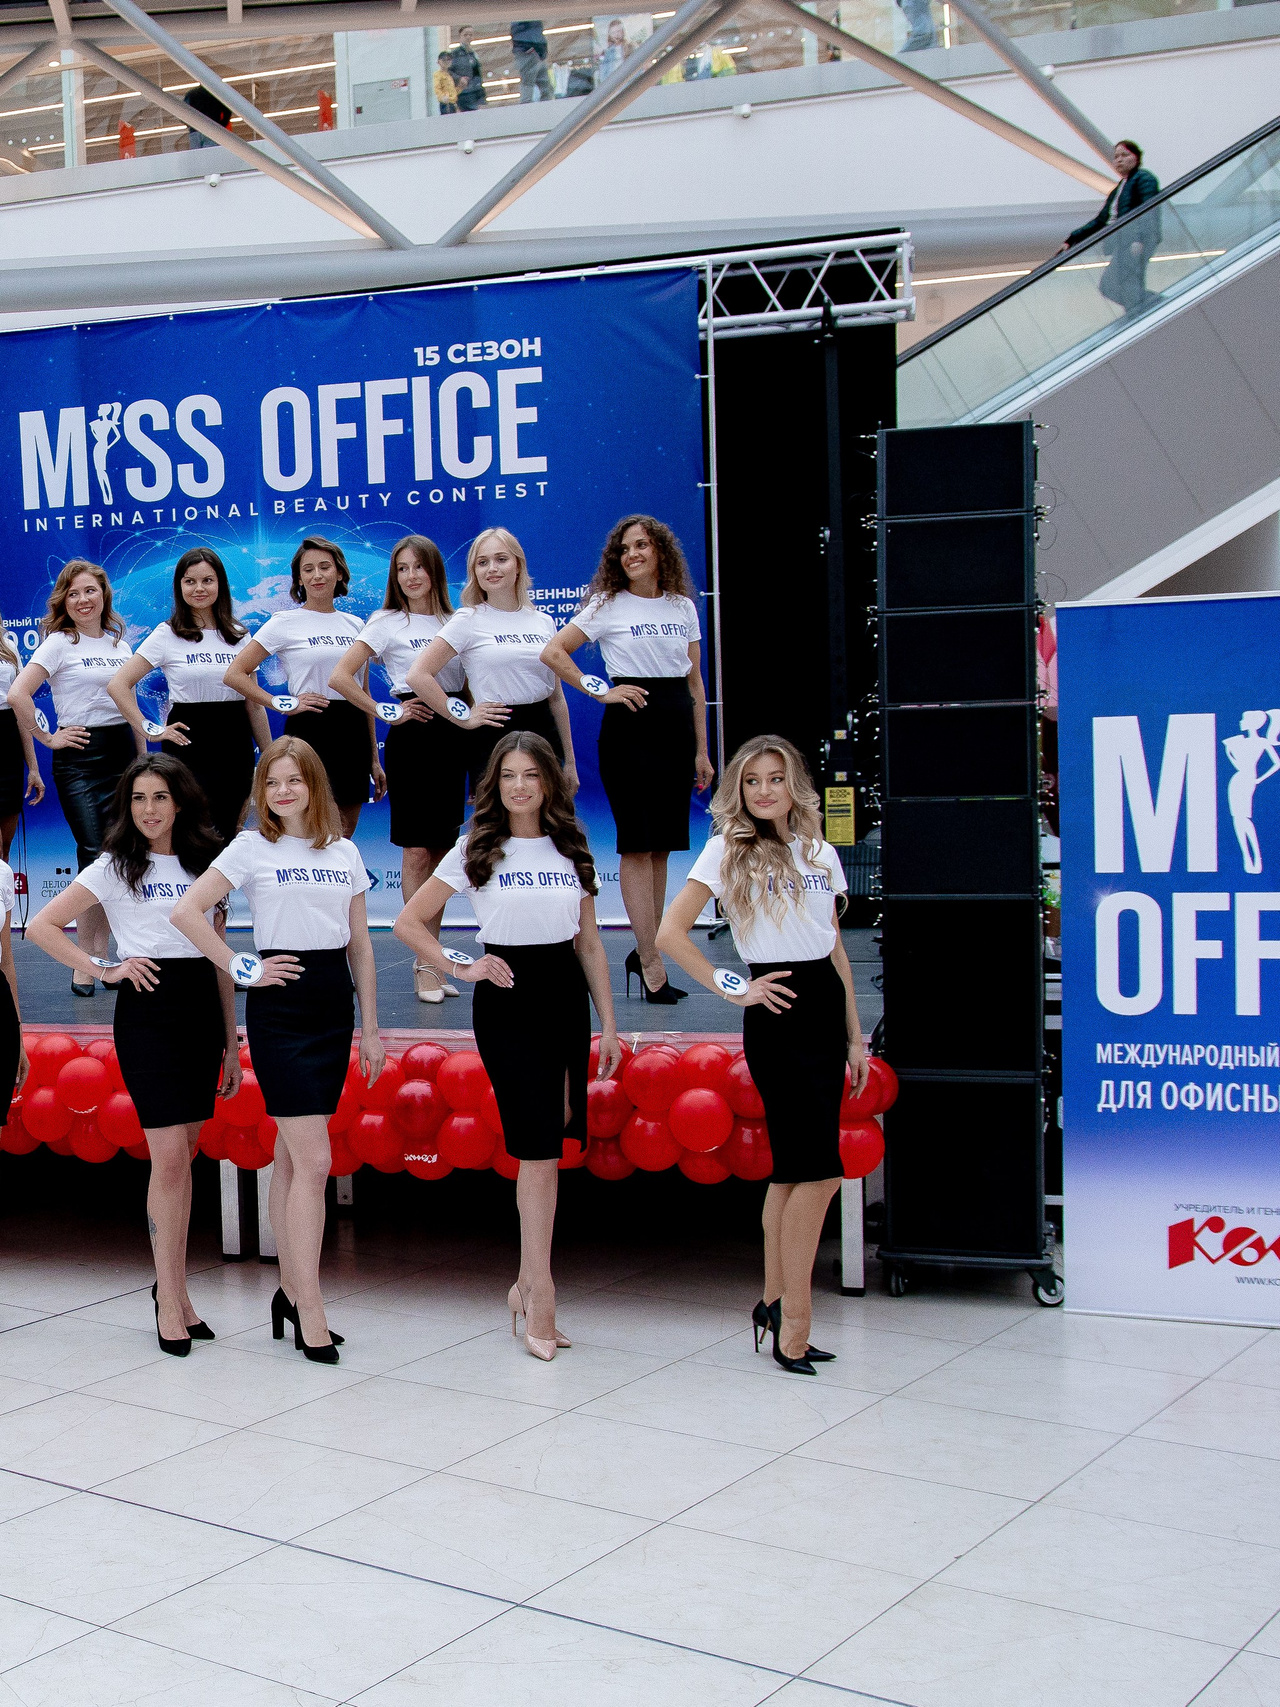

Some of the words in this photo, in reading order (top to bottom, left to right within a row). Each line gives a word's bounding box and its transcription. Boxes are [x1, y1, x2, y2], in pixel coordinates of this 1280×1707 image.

[414, 346, 440, 366] 15
[447, 337, 542, 364] СЕЗОН
[260, 367, 548, 492] OFFICE
[24, 502, 260, 532] INTERNATIONAL
[274, 493, 392, 514] BEAUTY
[407, 482, 548, 506] CONTEST
[586, 677, 604, 692] 34
[279, 697, 293, 709] 31
[383, 705, 396, 719] 32
[451, 700, 467, 716] 33
[37, 714, 47, 729] 27
[312, 868, 351, 885] OFFICE
[538, 871, 579, 889] OFFICE
[448, 953, 470, 963] 15
[1095, 891, 1280, 1016] OFF
[236, 956, 258, 980] 14
[720, 973, 741, 991] 16
[1096, 1042, 1280, 1070] МЕЖДУНАРОДНЫЙ
[1096, 1079, 1152, 1113] ДЛЯ
[1160, 1081, 1280, 1113] ОФИСНЫ
[1174, 1203, 1244, 1215] УЧРЕДИТЕЛЬ
[1246, 1206, 1255, 1215] И
